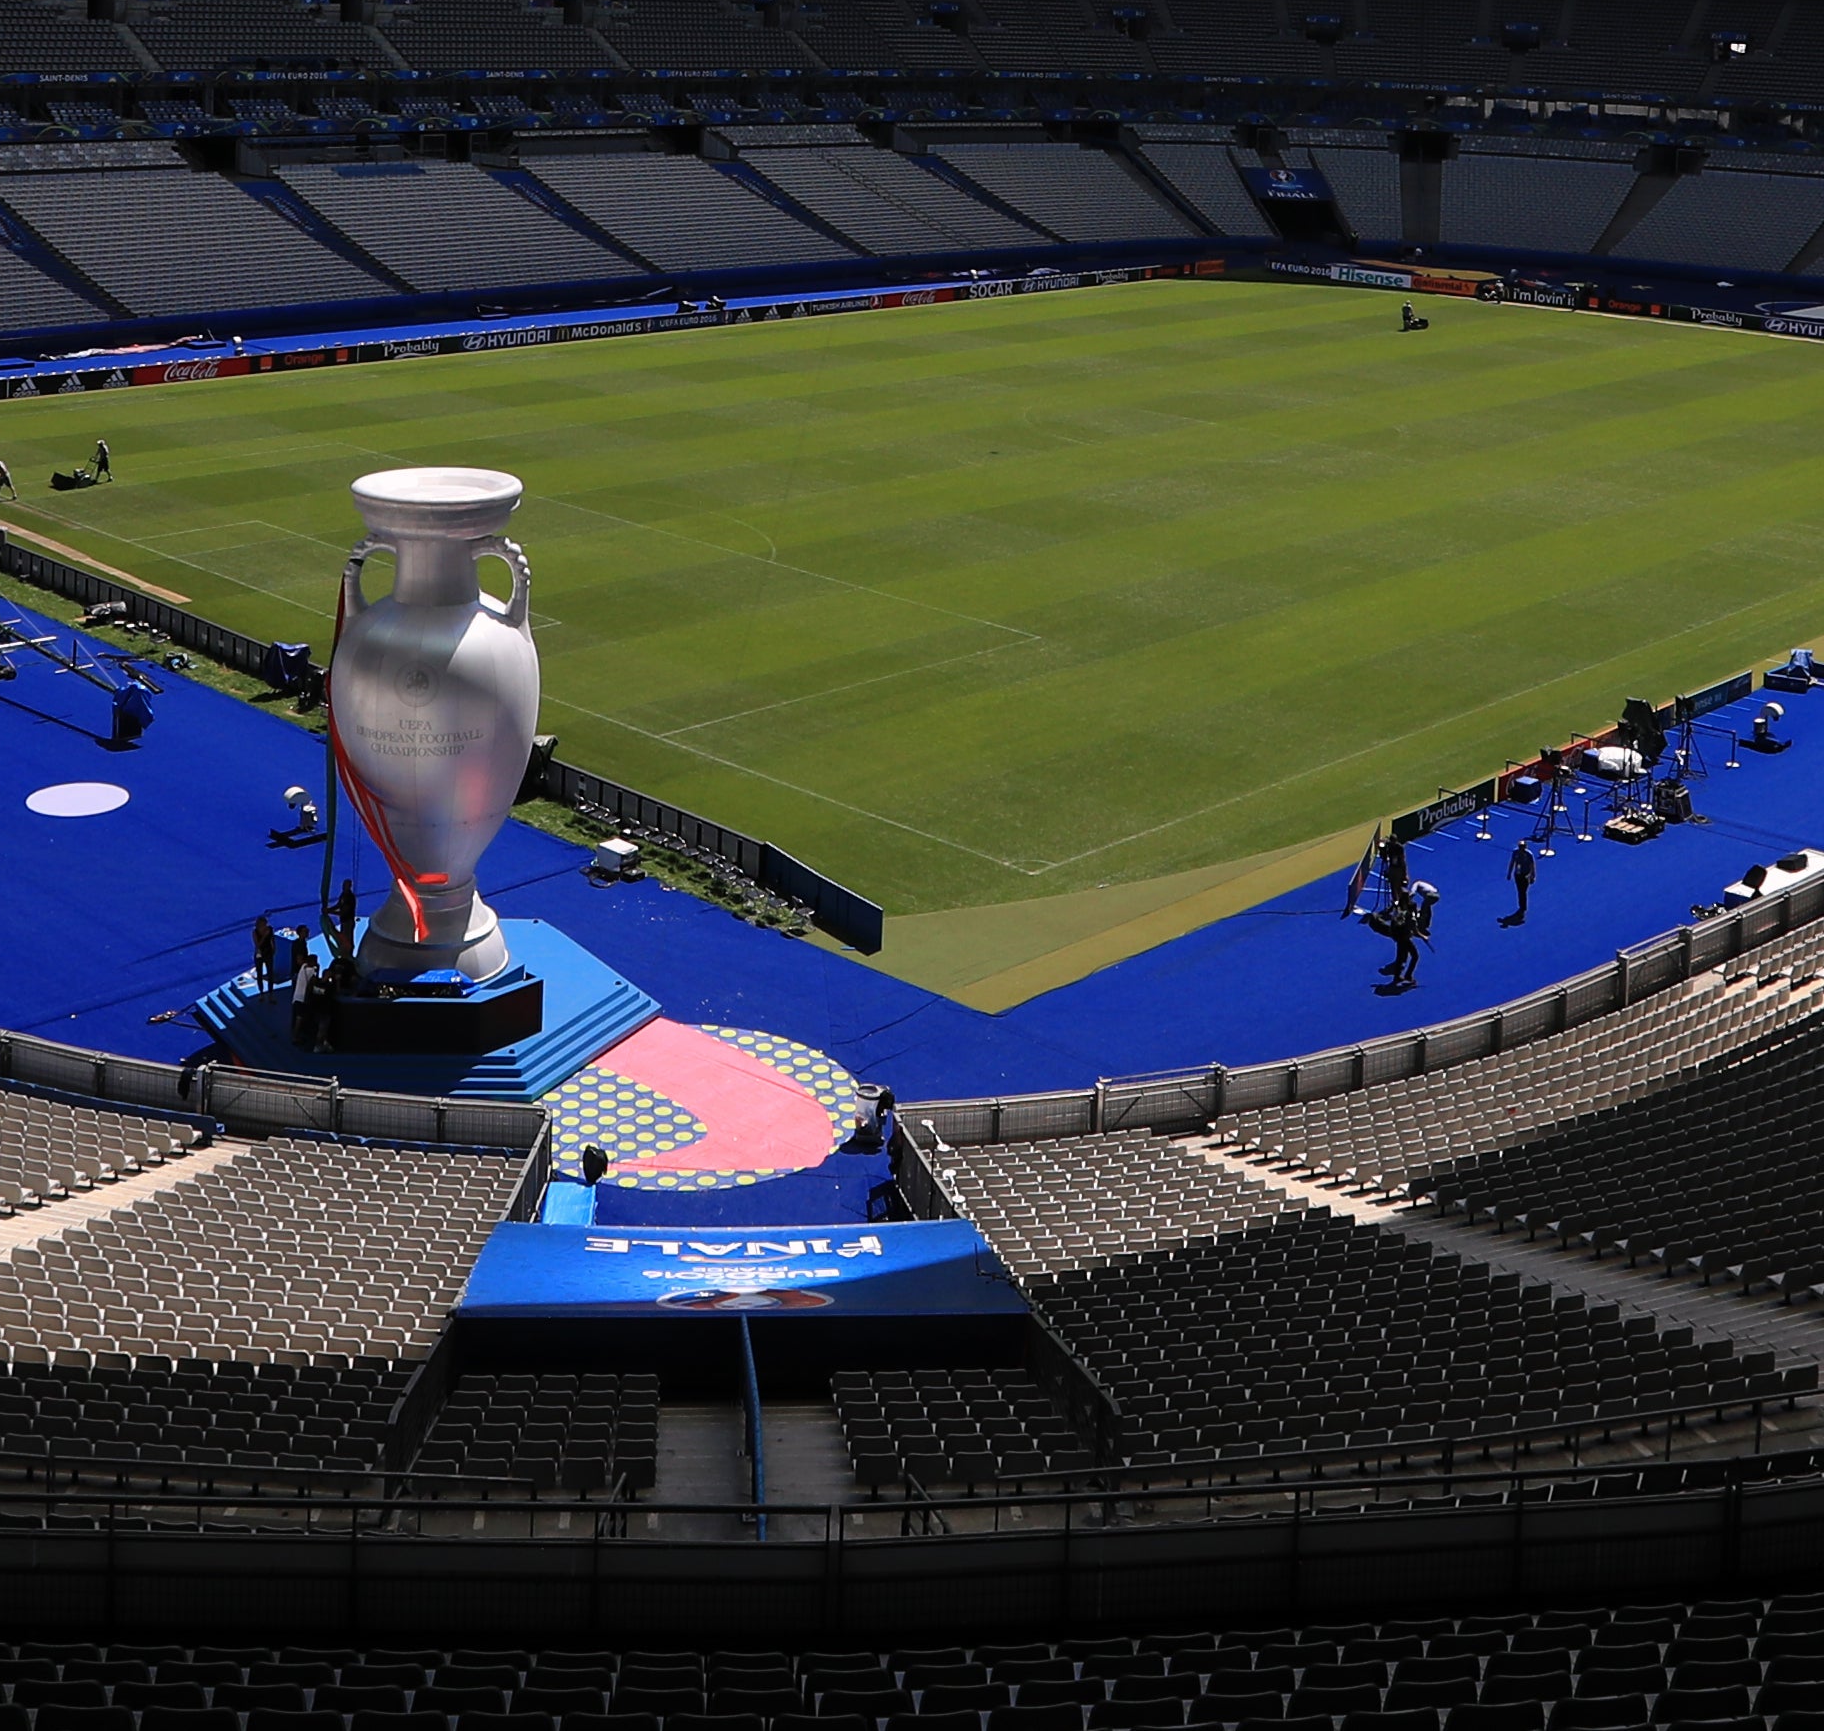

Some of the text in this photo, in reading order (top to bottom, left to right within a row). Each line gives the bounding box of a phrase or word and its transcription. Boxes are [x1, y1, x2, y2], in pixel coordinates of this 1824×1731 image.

[1036, 276, 1080, 290] HYUNDAI
[1338, 268, 1404, 287] Hisense
[968, 282, 1014, 299] SOCAR
[1513, 287, 1532, 302] i'm
[1533, 287, 1566, 305] lovin'
[1608, 298, 1642, 313] Orange
[1690, 307, 1743, 327] Probably
[571, 319, 642, 340] McDonald's
[383, 338, 440, 357] Probably
[487, 329, 551, 350] HYUNDAI
[283, 352, 325, 368] Orange
[356, 724, 484, 744] EUROPEAN FOOTBALL
[399, 718, 433, 731] UEFA
[370, 742, 465, 758] CHAMPIONSHIP
[1416, 792, 1477, 831] Probably
[584, 1234, 884, 1257] FINALE
